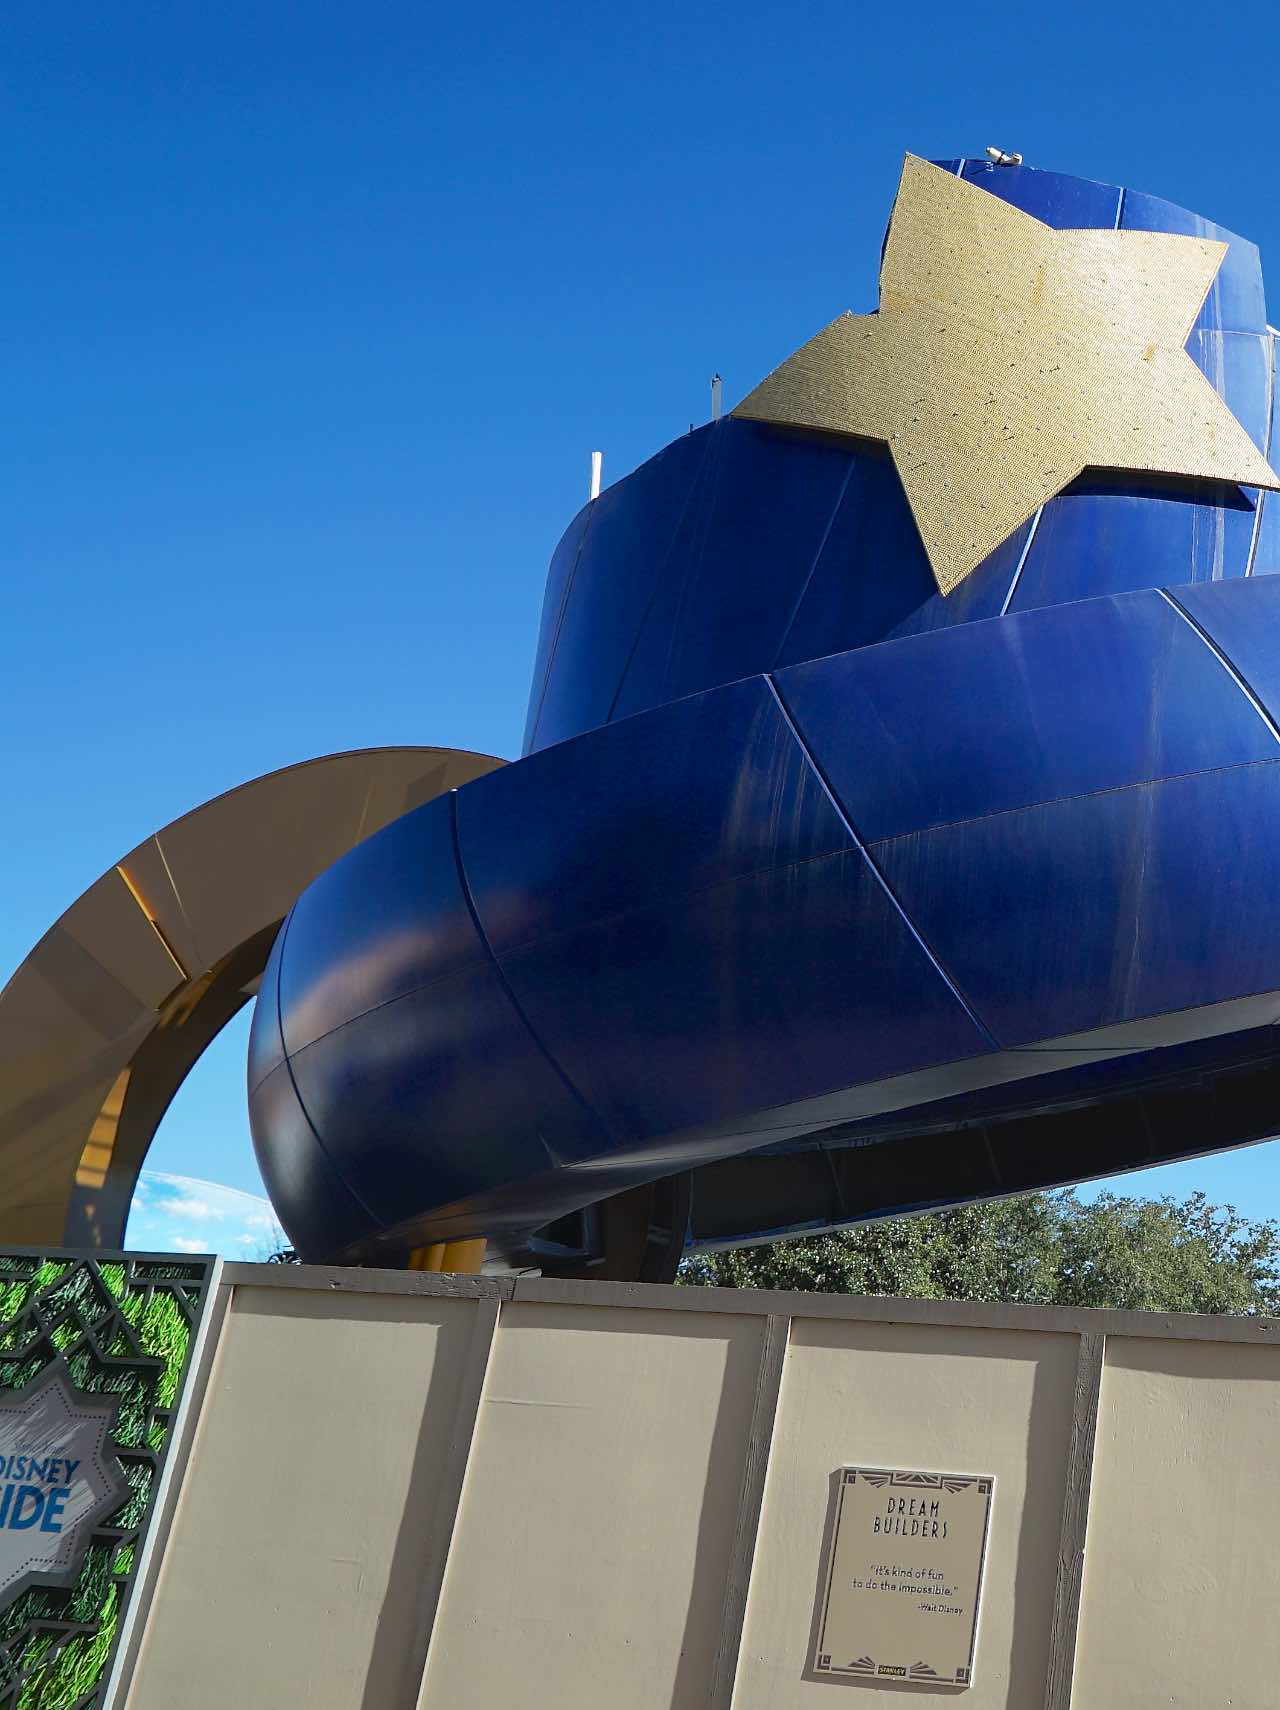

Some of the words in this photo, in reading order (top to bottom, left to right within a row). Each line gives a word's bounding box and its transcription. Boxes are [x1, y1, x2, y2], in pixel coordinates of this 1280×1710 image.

[0, 1455, 80, 1484] ISNEY
[0, 1484, 72, 1533] IDE
[887, 1497, 940, 1517] DREAM
[873, 1516, 948, 1539] BUILDERS
[892, 1566, 913, 1578] kind
[915, 1568, 926, 1579] of
[928, 1569, 944, 1581] fun
[853, 1579, 863, 1588] to
[866, 1579, 877, 1589] do
[880, 1581, 896, 1591] the
[938, 1604, 963, 1616] Disney
